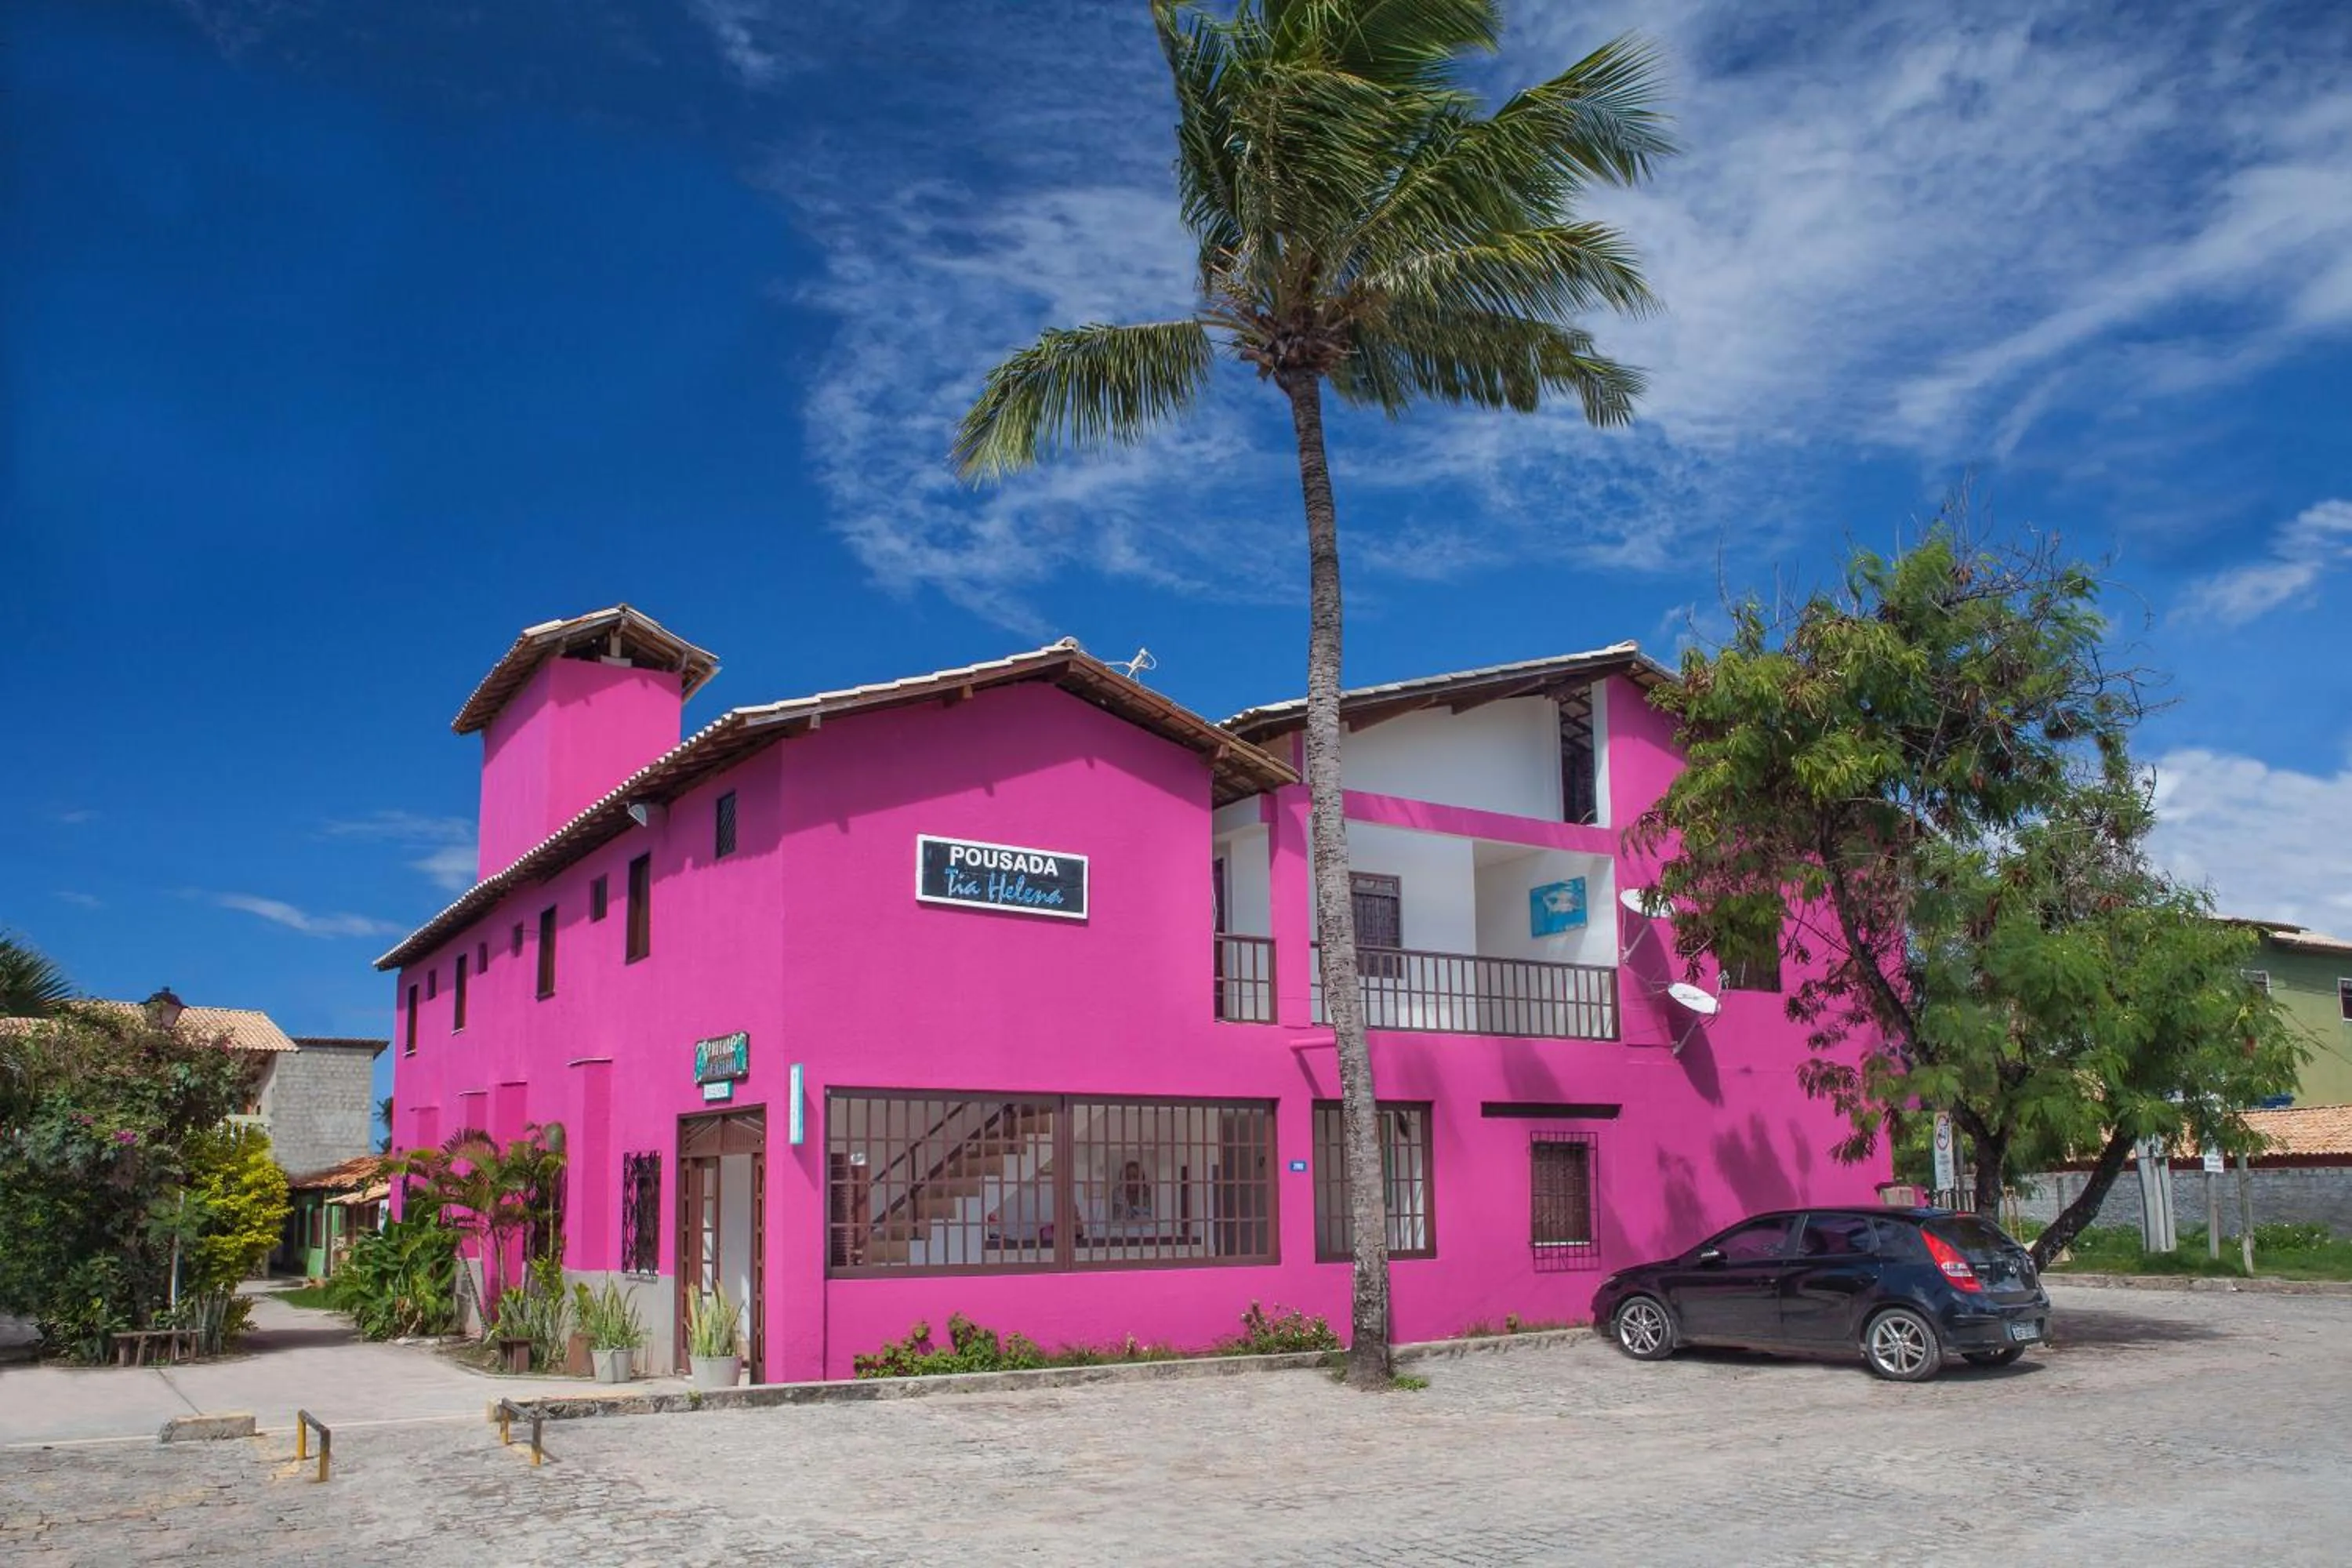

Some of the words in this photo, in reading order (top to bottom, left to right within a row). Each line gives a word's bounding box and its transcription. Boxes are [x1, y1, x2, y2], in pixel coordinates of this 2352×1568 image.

[949, 846, 1058, 876] POUSADA
[945, 866, 980, 896] Tia
[988, 871, 1064, 903] Helena
